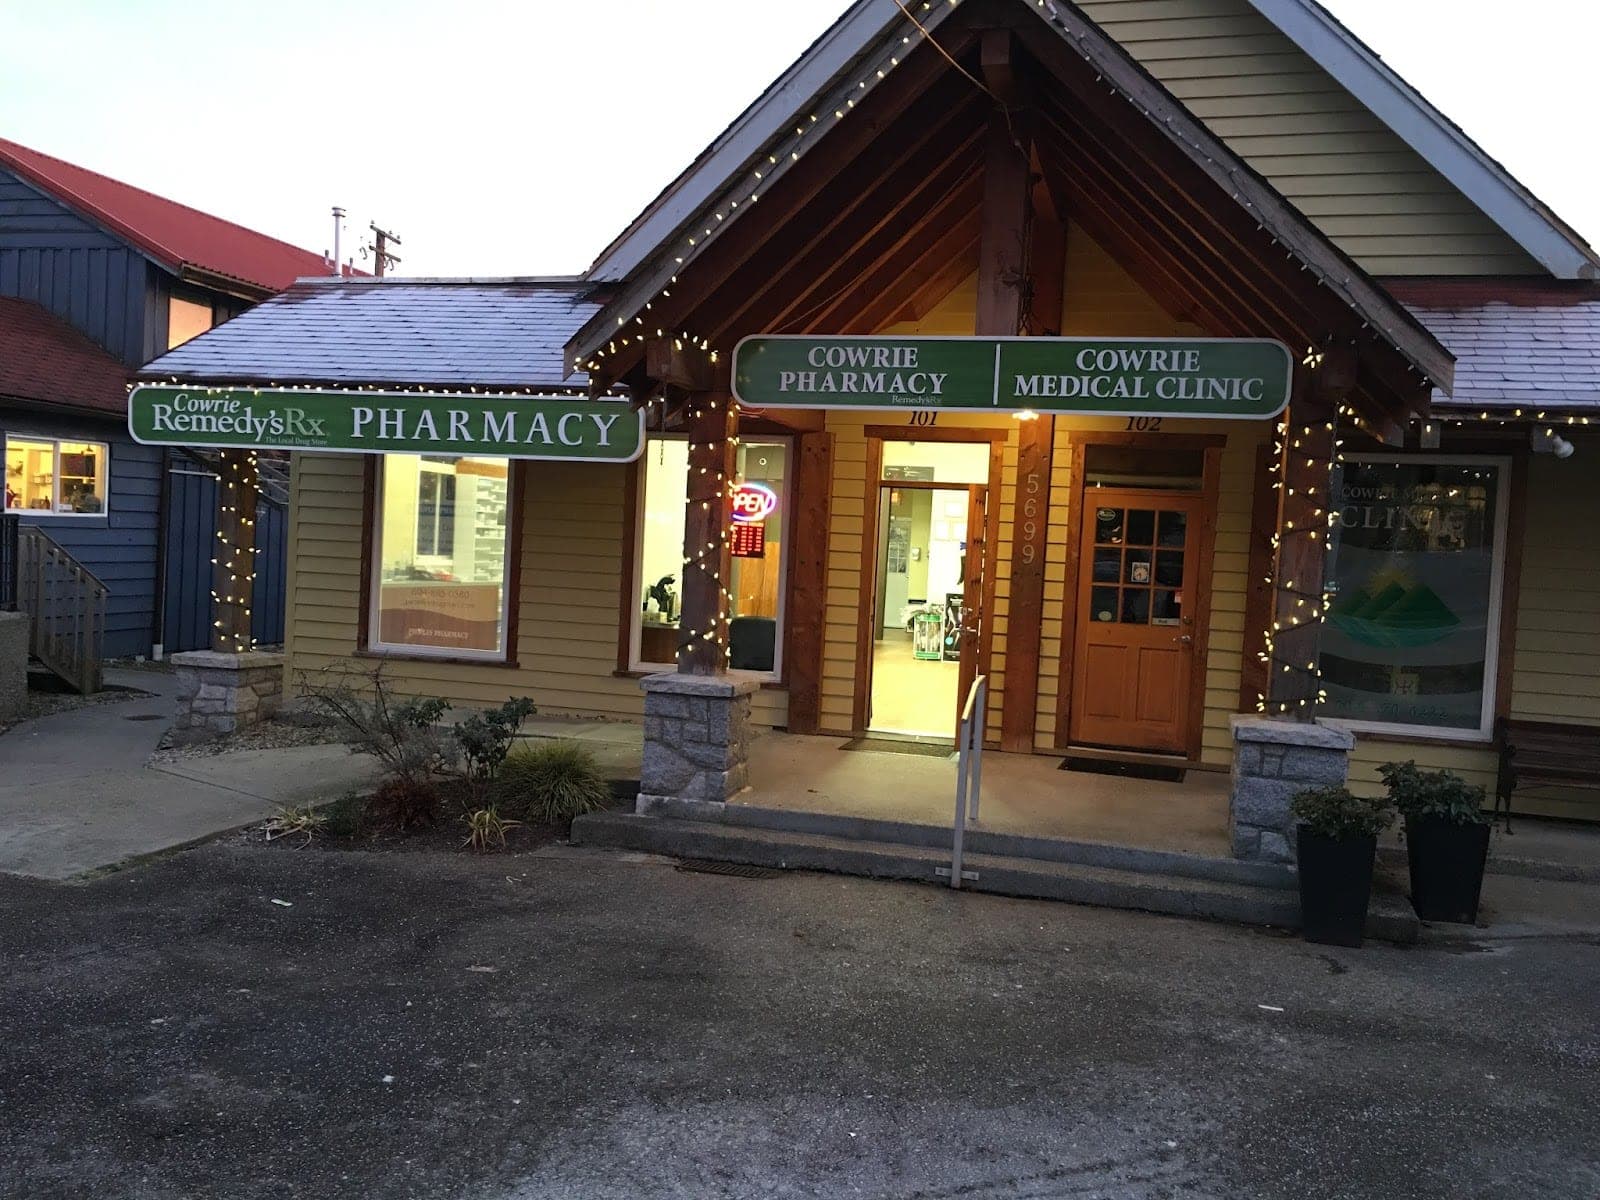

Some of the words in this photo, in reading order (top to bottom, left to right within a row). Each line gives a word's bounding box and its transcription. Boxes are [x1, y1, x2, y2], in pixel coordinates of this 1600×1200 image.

[808, 346, 919, 368] COWRIE
[1075, 348, 1200, 372] COWRIE
[779, 371, 948, 394] PHARMACY
[1013, 375, 1150, 399] MEDICAL
[1155, 377, 1264, 401] CLINIC
[173, 393, 241, 413] Cowrie
[350, 406, 621, 446] PHARMACY
[908, 411, 938, 426] 101
[1124, 416, 1161, 432] 102
[1339, 505, 1462, 531] CLIN
